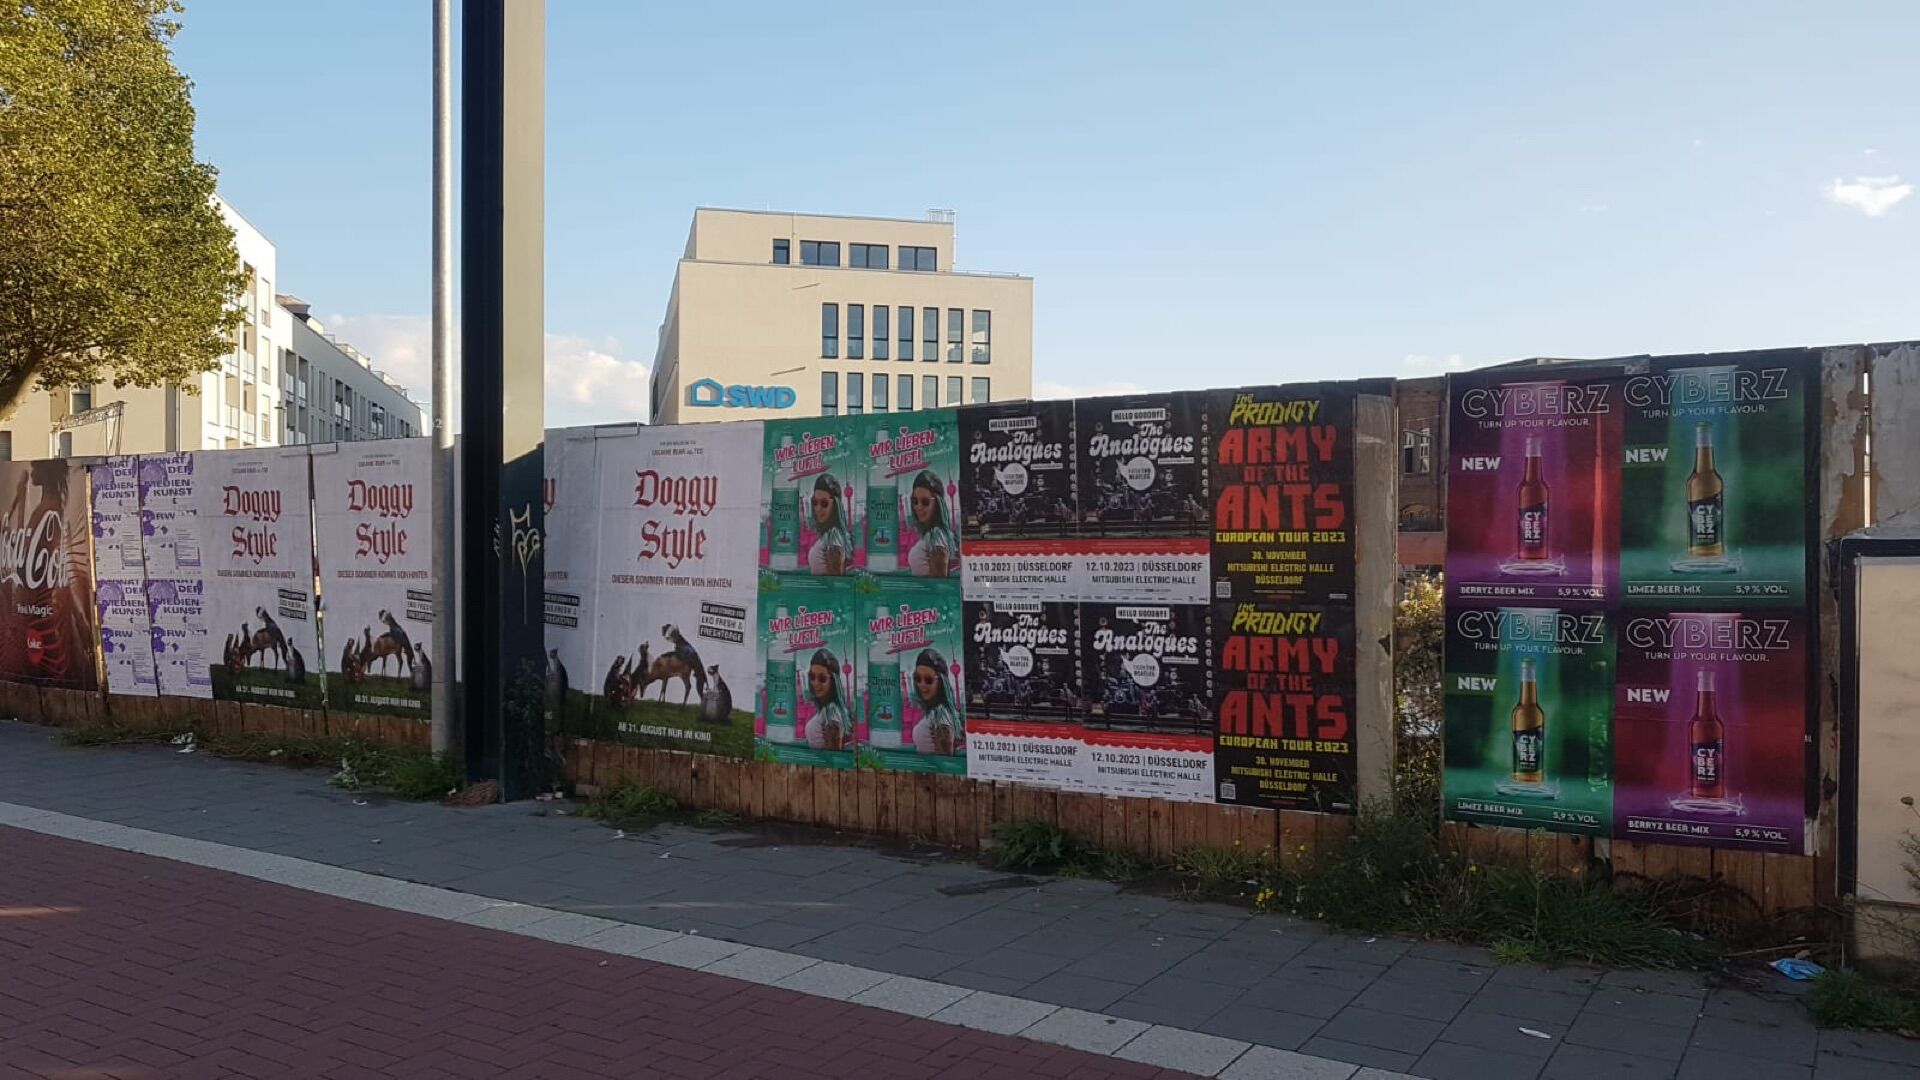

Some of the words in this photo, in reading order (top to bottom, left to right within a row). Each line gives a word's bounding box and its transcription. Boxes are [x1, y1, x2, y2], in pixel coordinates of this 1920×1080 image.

[1624, 367, 1788, 407] CYBERZ
[725, 384, 797, 409] SWD
[1461, 384, 1610, 418] CYBERZ
[1230, 400, 1320, 425] PRODIGY
[1643, 409, 1669, 418] TURN
[1672, 408, 1685, 417] UP
[1687, 407, 1715, 416] YOUR
[1719, 404, 1768, 414] FLAVOUR.
[1138, 423, 1163, 436] The
[1478, 420, 1501, 429] TURN
[1505, 419, 1517, 428] UP
[1519, 419, 1544, 428] YOUR
[1547, 418, 1591, 427] FLAVOUR.
[869, 440, 894, 458] WIR
[895, 430, 936, 451] LIEBEN
[1013, 431, 1034, 443] The
[1218, 425, 1337, 464] ARMY
[774, 444, 797, 462] WIR
[798, 434, 836, 456] LIEBEN
[970, 441, 1062, 466] Analogues
[1089, 434, 1194, 460] Analogues
[1625, 447, 1669, 463] NEW
[889, 449, 923, 470] LUFT!
[1461, 456, 1501, 471] NEW
[1244, 466, 1266, 482] OF
[1274, 464, 1310, 481] THE
[101, 490, 136, 499] KUNST
[153, 488, 193, 497] KUNST
[346, 478, 413, 519] Doggy
[633, 468, 718, 517] Doggy
[222, 485, 281, 523] Doggy
[1216, 483, 1345, 529] ANTS
[231, 523, 278, 565] Style
[355, 521, 407, 565] Style
[637, 518, 707, 570] Style
[1215, 532, 1275, 543] EUROPEAN
[1278, 532, 1310, 543] TOUR
[1312, 532, 1345, 543] 2023
[1265, 551, 1307, 560] NOVEMBER
[968, 562, 1011, 572] 12.10.2023
[1017, 561, 1073, 572] DÜSSELDORF
[1086, 561, 1135, 572] 12.10.2023
[1142, 560, 1203, 572] DÜSSELDORF
[1227, 563, 1268, 572] MITSUBISHI
[1270, 563, 1306, 572] ELECTRIC
[1308, 563, 1334, 573] HALLE
[973, 575, 1010, 583] MITSUBISHI
[1012, 575, 1043, 583] ELECTRIC
[1044, 575, 1067, 583] HALLE
[1092, 575, 1134, 584] MITSUBISHI
[1135, 575, 1170, 584] ELECTRIC
[1171, 576, 1196, 584] HALLE
[1494, 587, 1515, 595] BEER
[1518, 587, 1535, 595] MIX
[1582, 588, 1604, 597] VOL.
[1627, 585, 1655, 594] LIMEZ
[1657, 585, 1681, 594] BEER
[1683, 585, 1701, 594] MIX
[1763, 585, 1788, 594] VOL.
[111, 607, 146, 616] KUNST
[163, 606, 202, 615] KUNST
[769, 617, 792, 633] WIR
[793, 610, 833, 630] LIEBEN
[869, 616, 894, 633] WIR
[896, 608, 938, 627] LIEBEN
[1017, 614, 1039, 626] The
[1142, 621, 1167, 635] The
[1231, 612, 1322, 634] PRODIGY
[1457, 610, 1604, 644] CYBERZ
[788, 628, 820, 645] LUFT!
[890, 627, 924, 645] LUFT!
[973, 622, 1067, 649] Analogues
[1626, 617, 1790, 650] CYBERZ
[1093, 630, 1198, 658] Analogues
[1475, 642, 1497, 650] TURN
[1500, 643, 1512, 651] UP
[1514, 644, 1538, 653] YOUR
[1541, 645, 1586, 655] FLAVOUR.
[1222, 635, 1339, 673] ARMY
[1645, 651, 1671, 660] TURN
[1673, 651, 1687, 661] UP
[1690, 652, 1717, 661] YOUR
[1720, 653, 1770, 662] FLAVOUR.
[1247, 673, 1270, 690] OF
[1276, 674, 1313, 692] THE
[1457, 676, 1497, 691] NEW
[1627, 688, 1671, 703] NEW
[1220, 691, 1348, 739] ANTS
[640, 724, 666, 737] AUGUST
[694, 731, 711, 742] KINO
[973, 741, 1016, 752] 12.10.2023
[1023, 743, 1078, 756] DÜSSELDORF
[1219, 735, 1278, 750] EUROPEAN
[1281, 739, 1313, 751] TOUR
[1315, 741, 1349, 753] 2023
[978, 754, 1016, 763] MITSUBISHI
[1017, 756, 1048, 766] ELECTRIC
[1049, 758, 1073, 767] HALLE
[1091, 752, 1140, 764] 12.10.2023
[1147, 755, 1208, 769] DÜSSELDORF
[1269, 757, 1310, 768] NOVEMBER
[1097, 766, 1140, 776] MITSUBISHI
[1141, 768, 1176, 779] ELECTRIC
[1177, 772, 1201, 781] HALLE
[1231, 766, 1272, 777] MITSUBISHI
[1273, 769, 1310, 780] ELECTRIC
[1312, 772, 1338, 782] HALLE
[1484, 803, 1505, 814] BEER
[1506, 806, 1524, 816] MIX
[1577, 813, 1599, 824] VOL.
[1627, 820, 1663, 831] BERRYZ
[1665, 822, 1688, 832] BEER
[1691, 824, 1710, 834] MIX
[1763, 830, 1787, 841] VOL.
